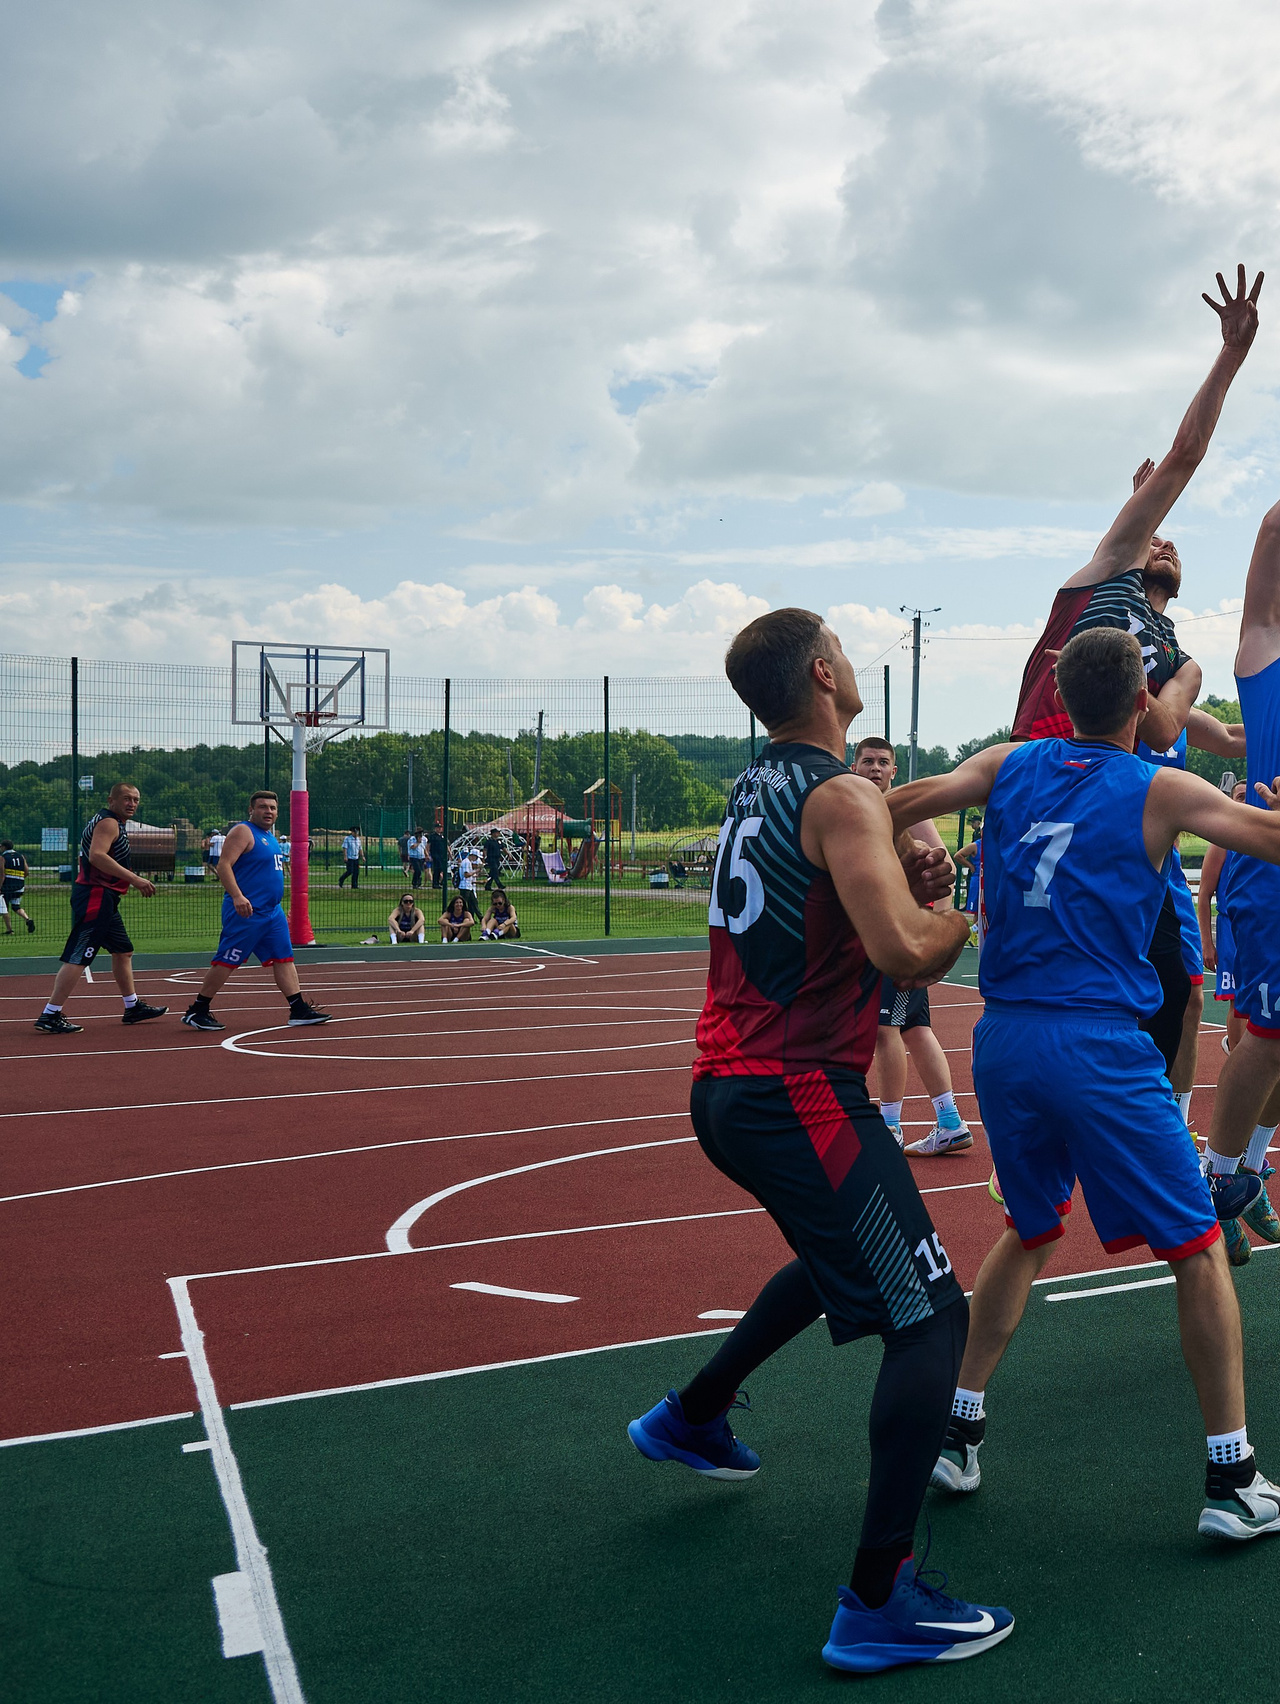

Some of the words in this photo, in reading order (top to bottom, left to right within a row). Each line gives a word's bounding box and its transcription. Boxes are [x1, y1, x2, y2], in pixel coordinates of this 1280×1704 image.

[12, 857, 20, 867] 11
[273, 854, 283, 871] 15
[1019, 821, 1075, 911] 7
[709, 815, 766, 935] 15
[84, 947, 94, 958] 8
[222, 948, 242, 962] 15
[914, 1231, 952, 1282] 15
